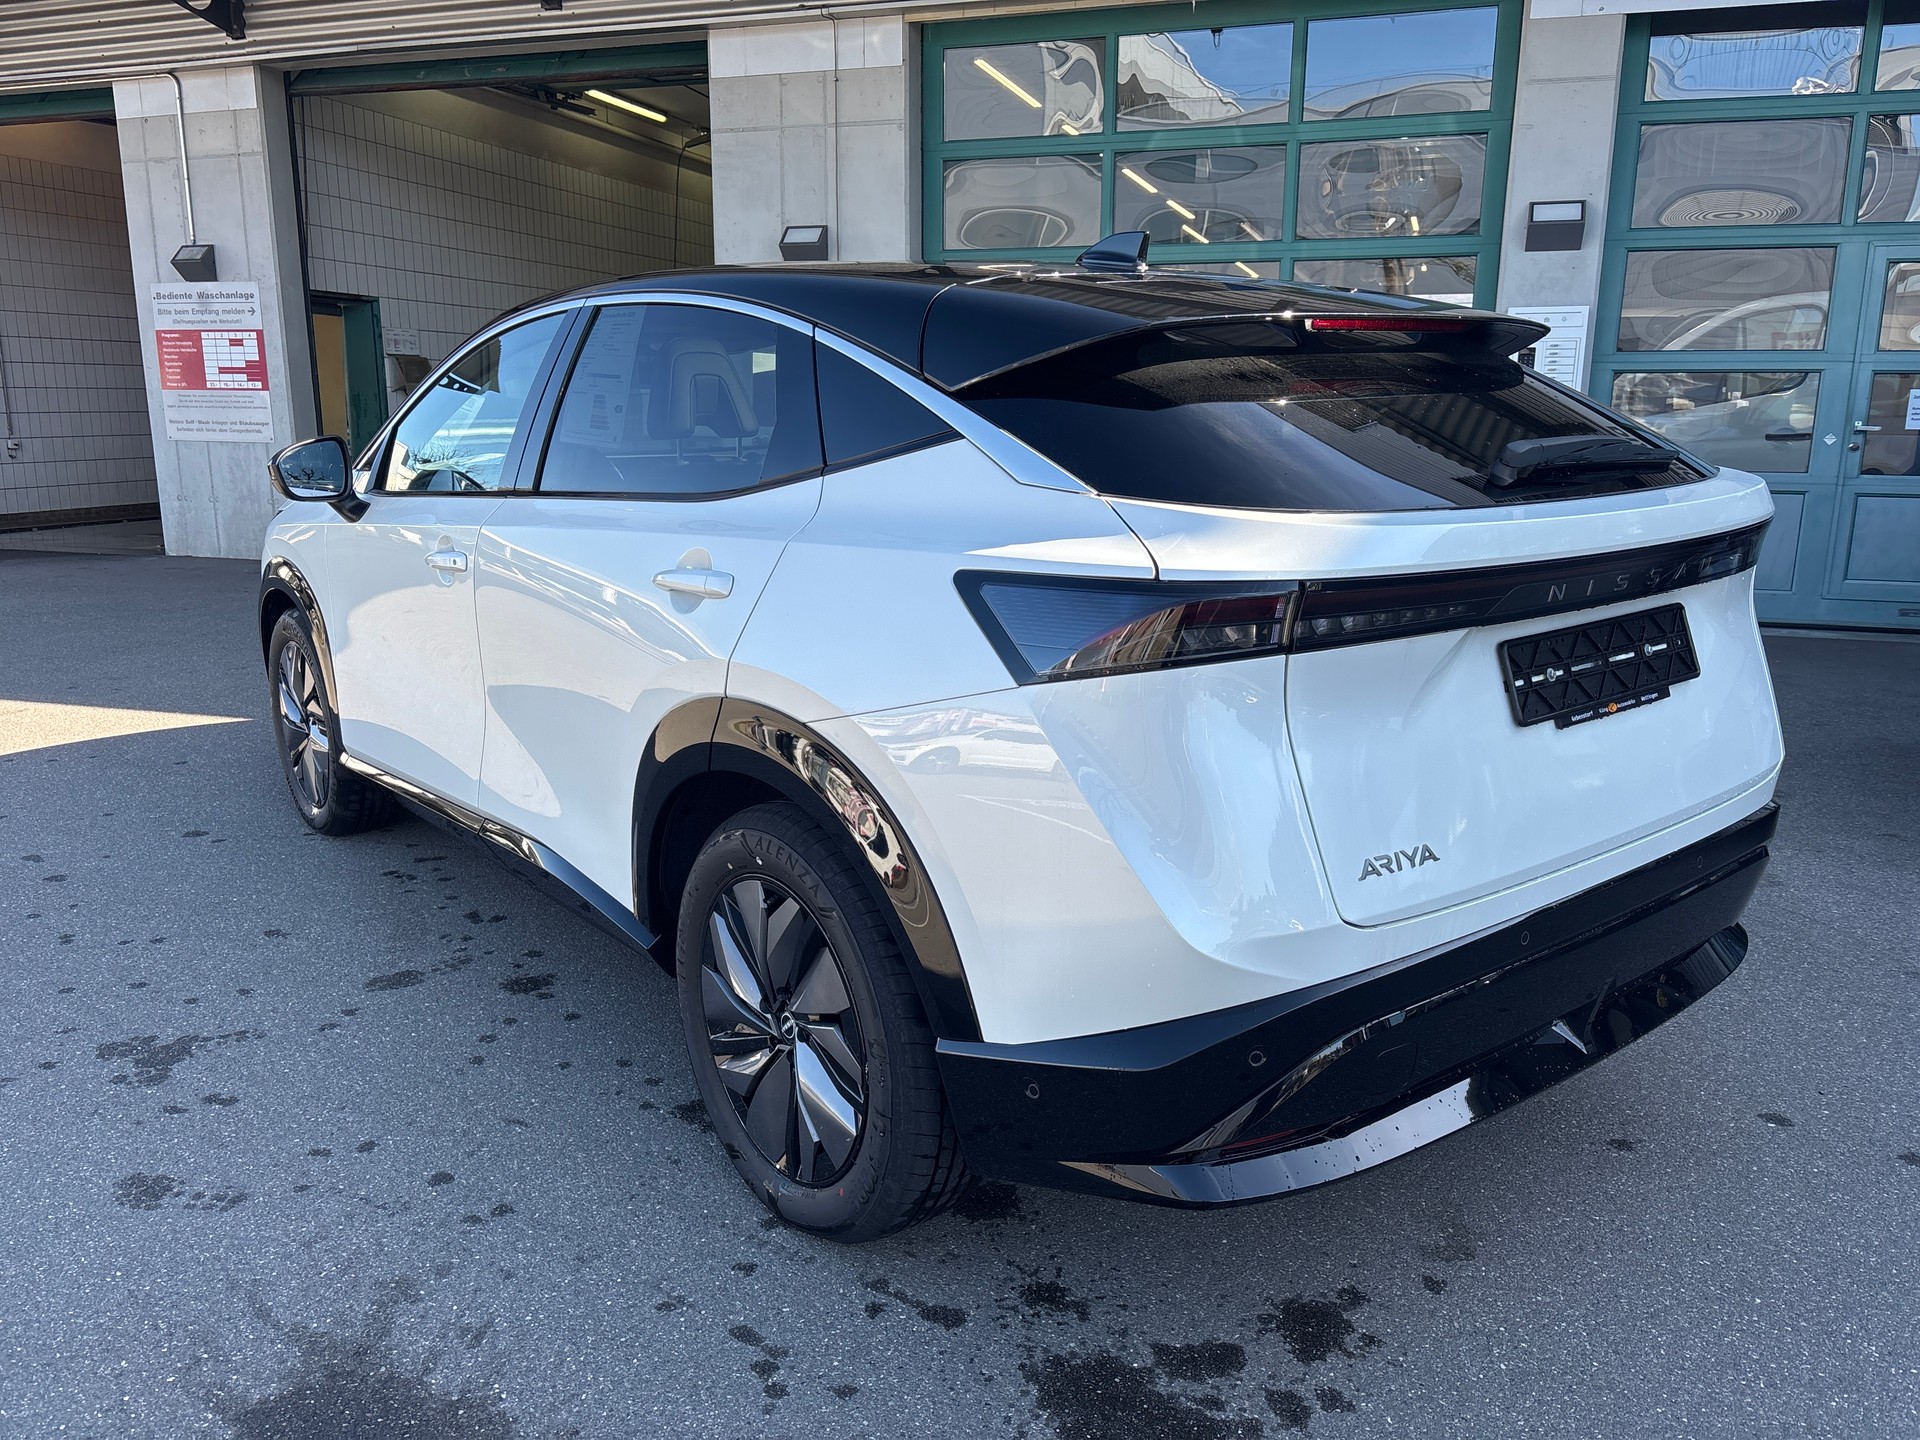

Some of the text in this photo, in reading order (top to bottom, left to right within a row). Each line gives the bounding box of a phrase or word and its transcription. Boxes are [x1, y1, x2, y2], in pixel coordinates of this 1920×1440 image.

[156, 291, 255, 300] Bediente Waschanlage
[191, 308, 220, 316] Empfang
[1547, 556, 1713, 603] NISSAN
[755, 835, 820, 900] ALENZA
[1358, 843, 1441, 882] ARIYA
